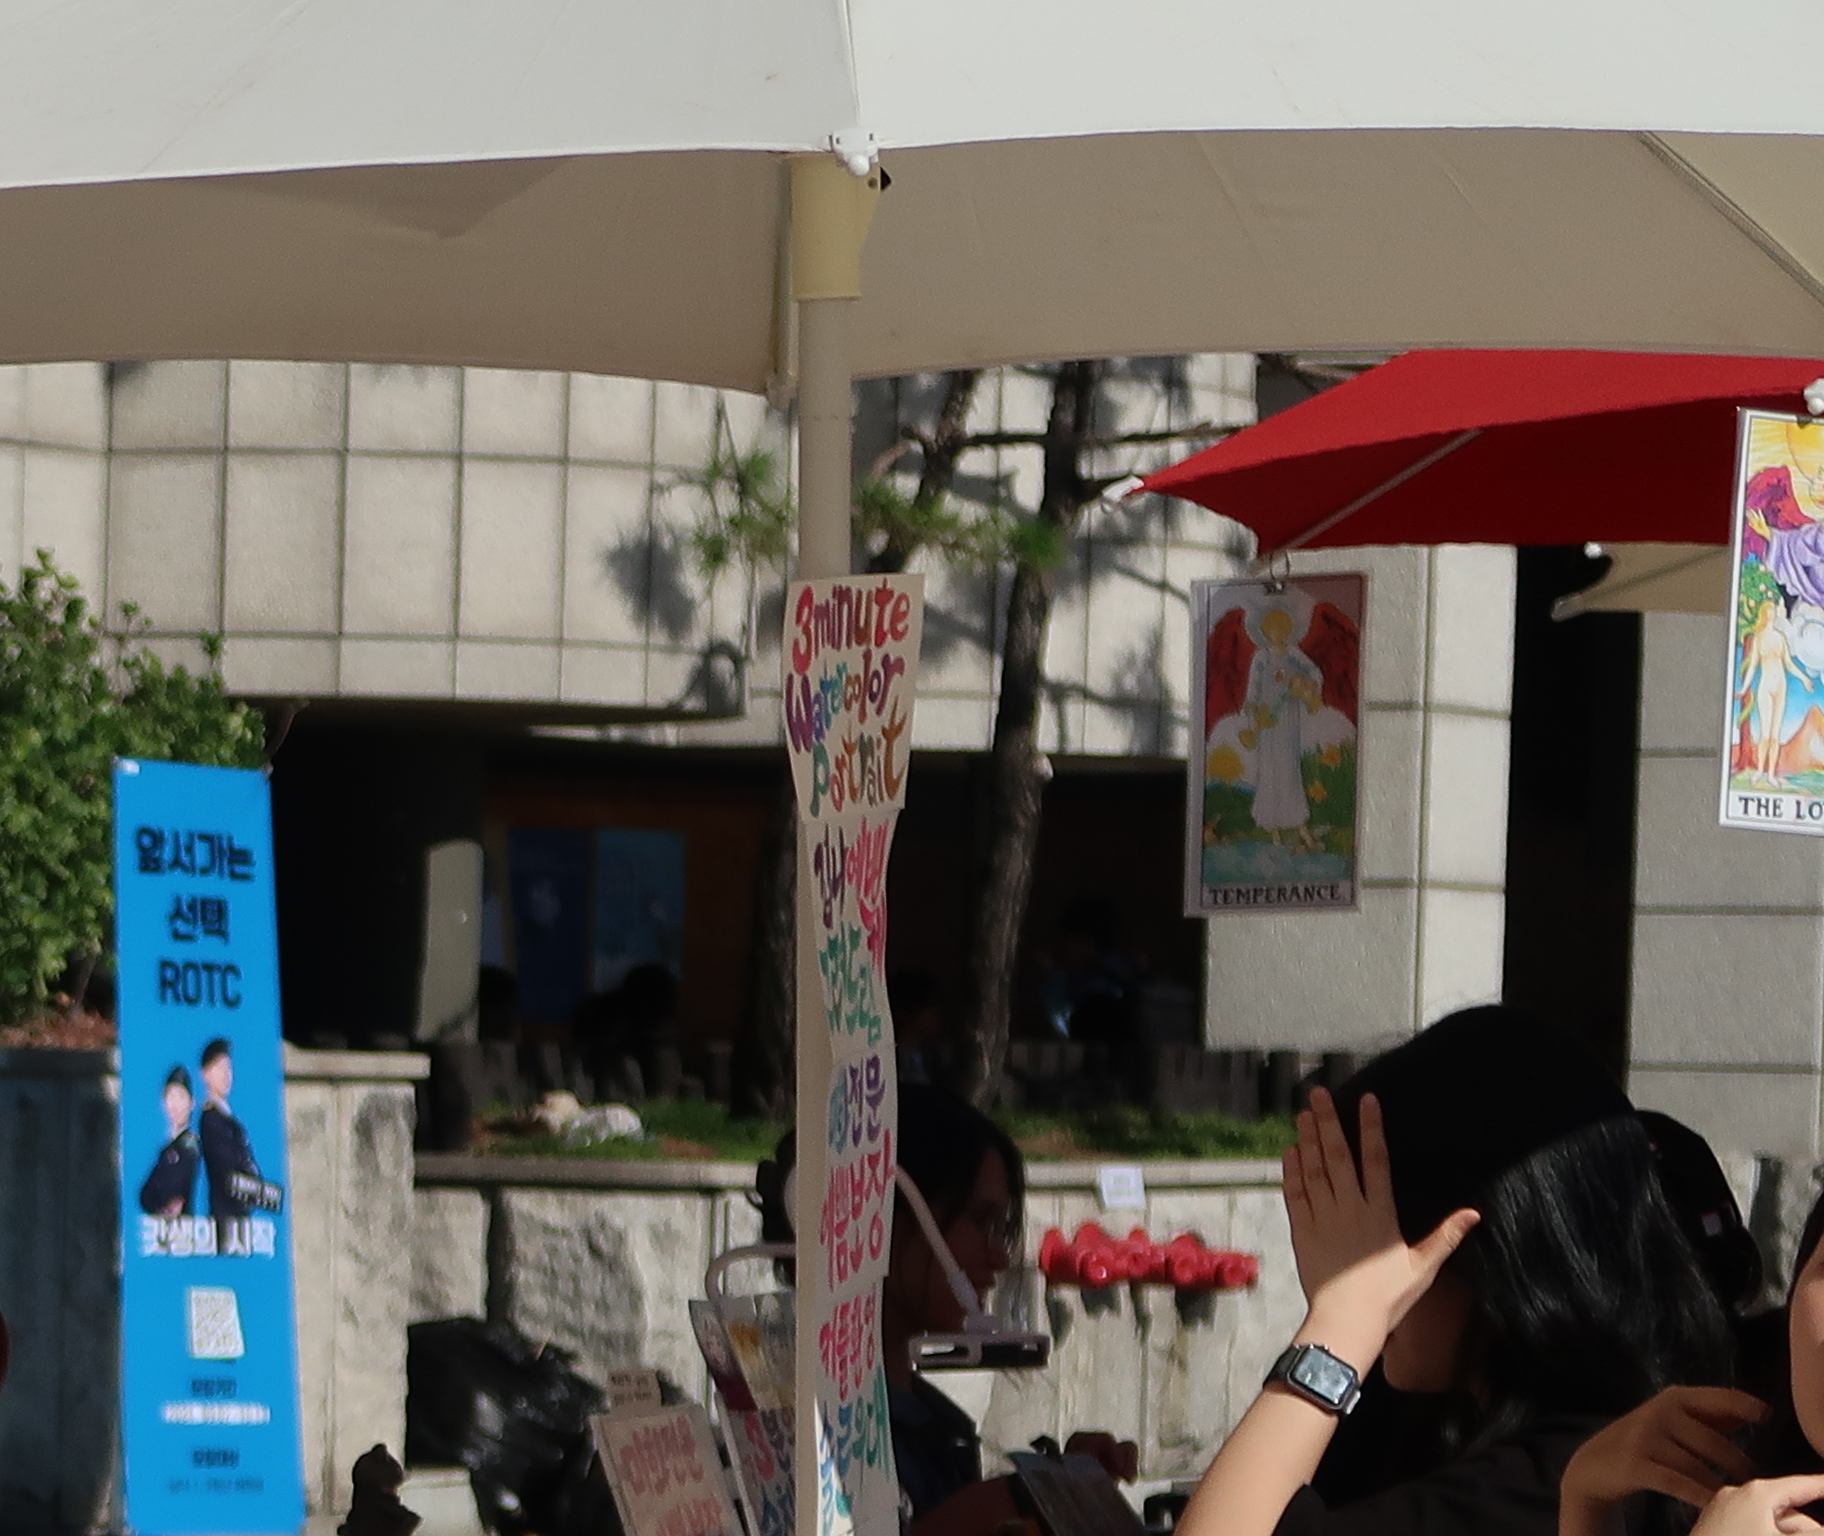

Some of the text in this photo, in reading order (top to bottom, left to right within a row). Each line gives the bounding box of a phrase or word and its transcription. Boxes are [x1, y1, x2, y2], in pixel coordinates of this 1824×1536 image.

[1738, 796, 1824, 821] THE LO
[136, 826, 256, 882] 앞서가는
[1209, 883, 1341, 906] TEMPERANCE
[167, 893, 230, 945] 선택
[159, 957, 244, 1009] ROTC
[227, 1216, 276, 1260] 시작
